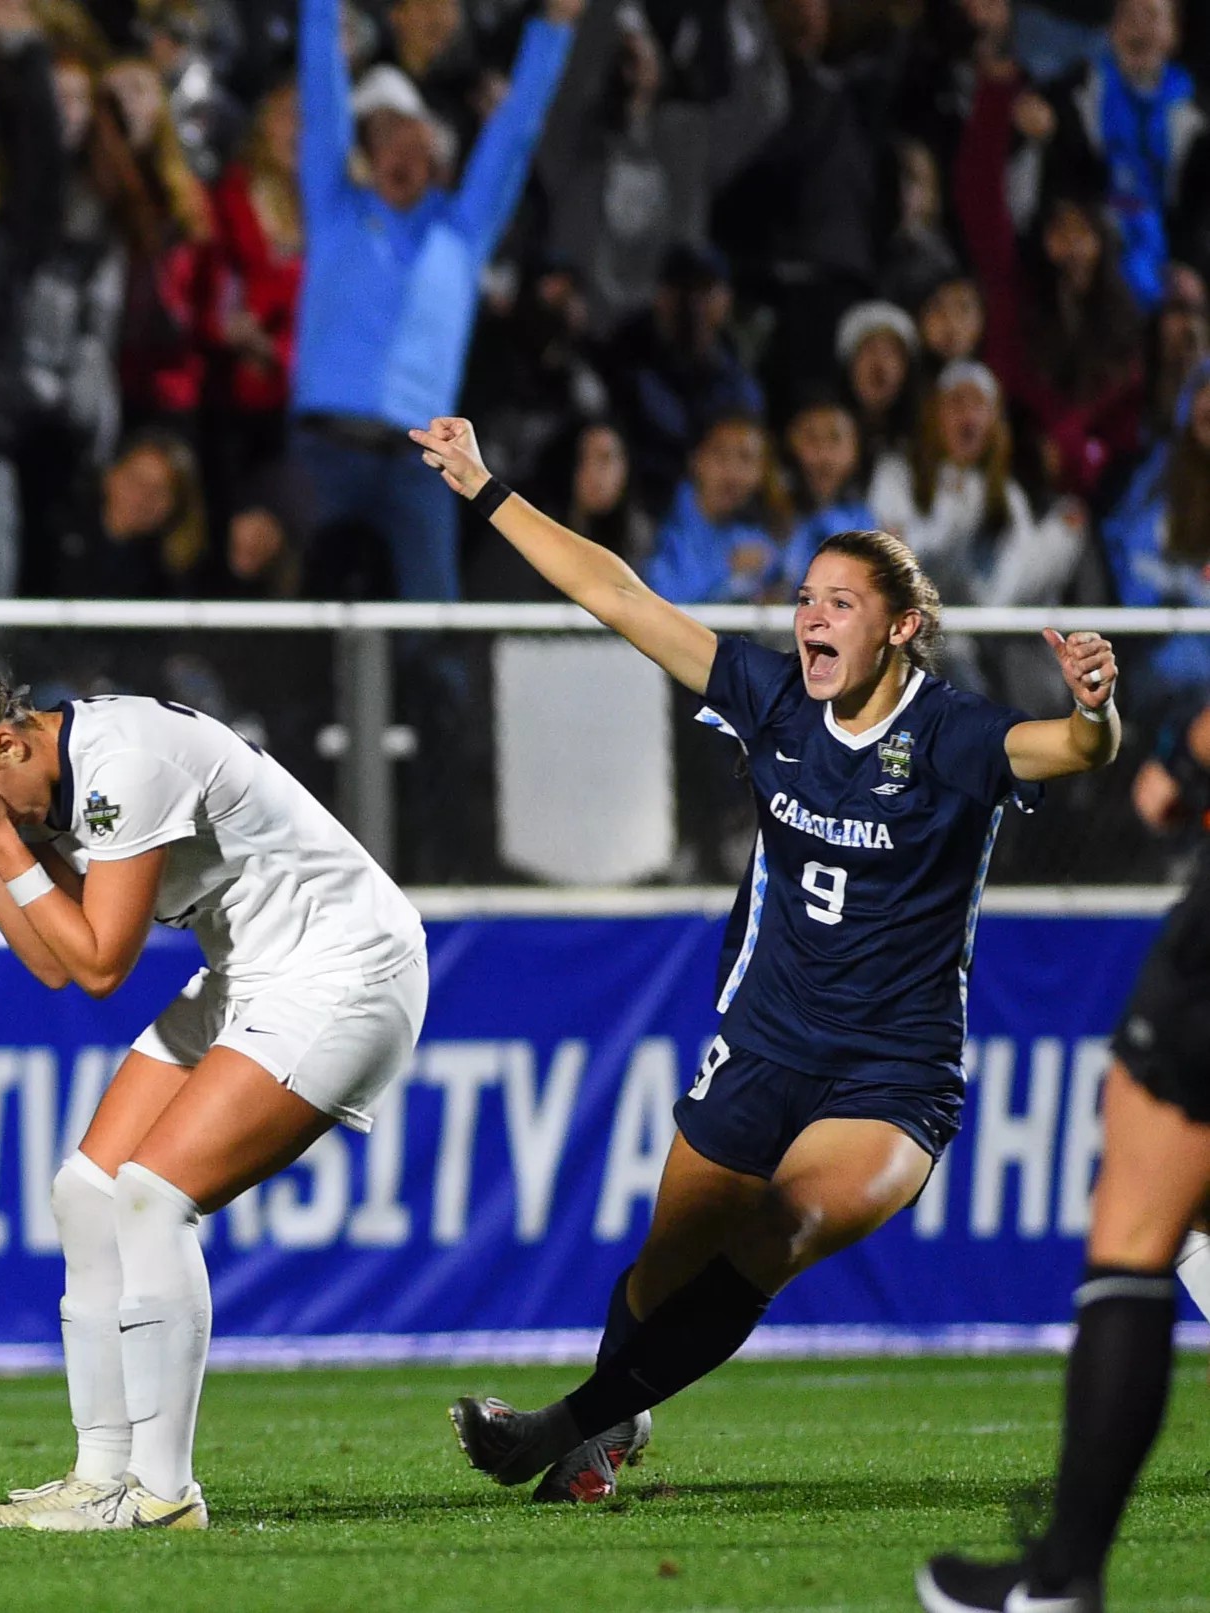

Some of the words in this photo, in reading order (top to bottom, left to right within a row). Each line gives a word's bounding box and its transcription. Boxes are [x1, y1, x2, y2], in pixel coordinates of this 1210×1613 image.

[769, 792, 895, 850] CAROLINA
[801, 861, 848, 926] 9
[688, 1034, 731, 1101] 9
